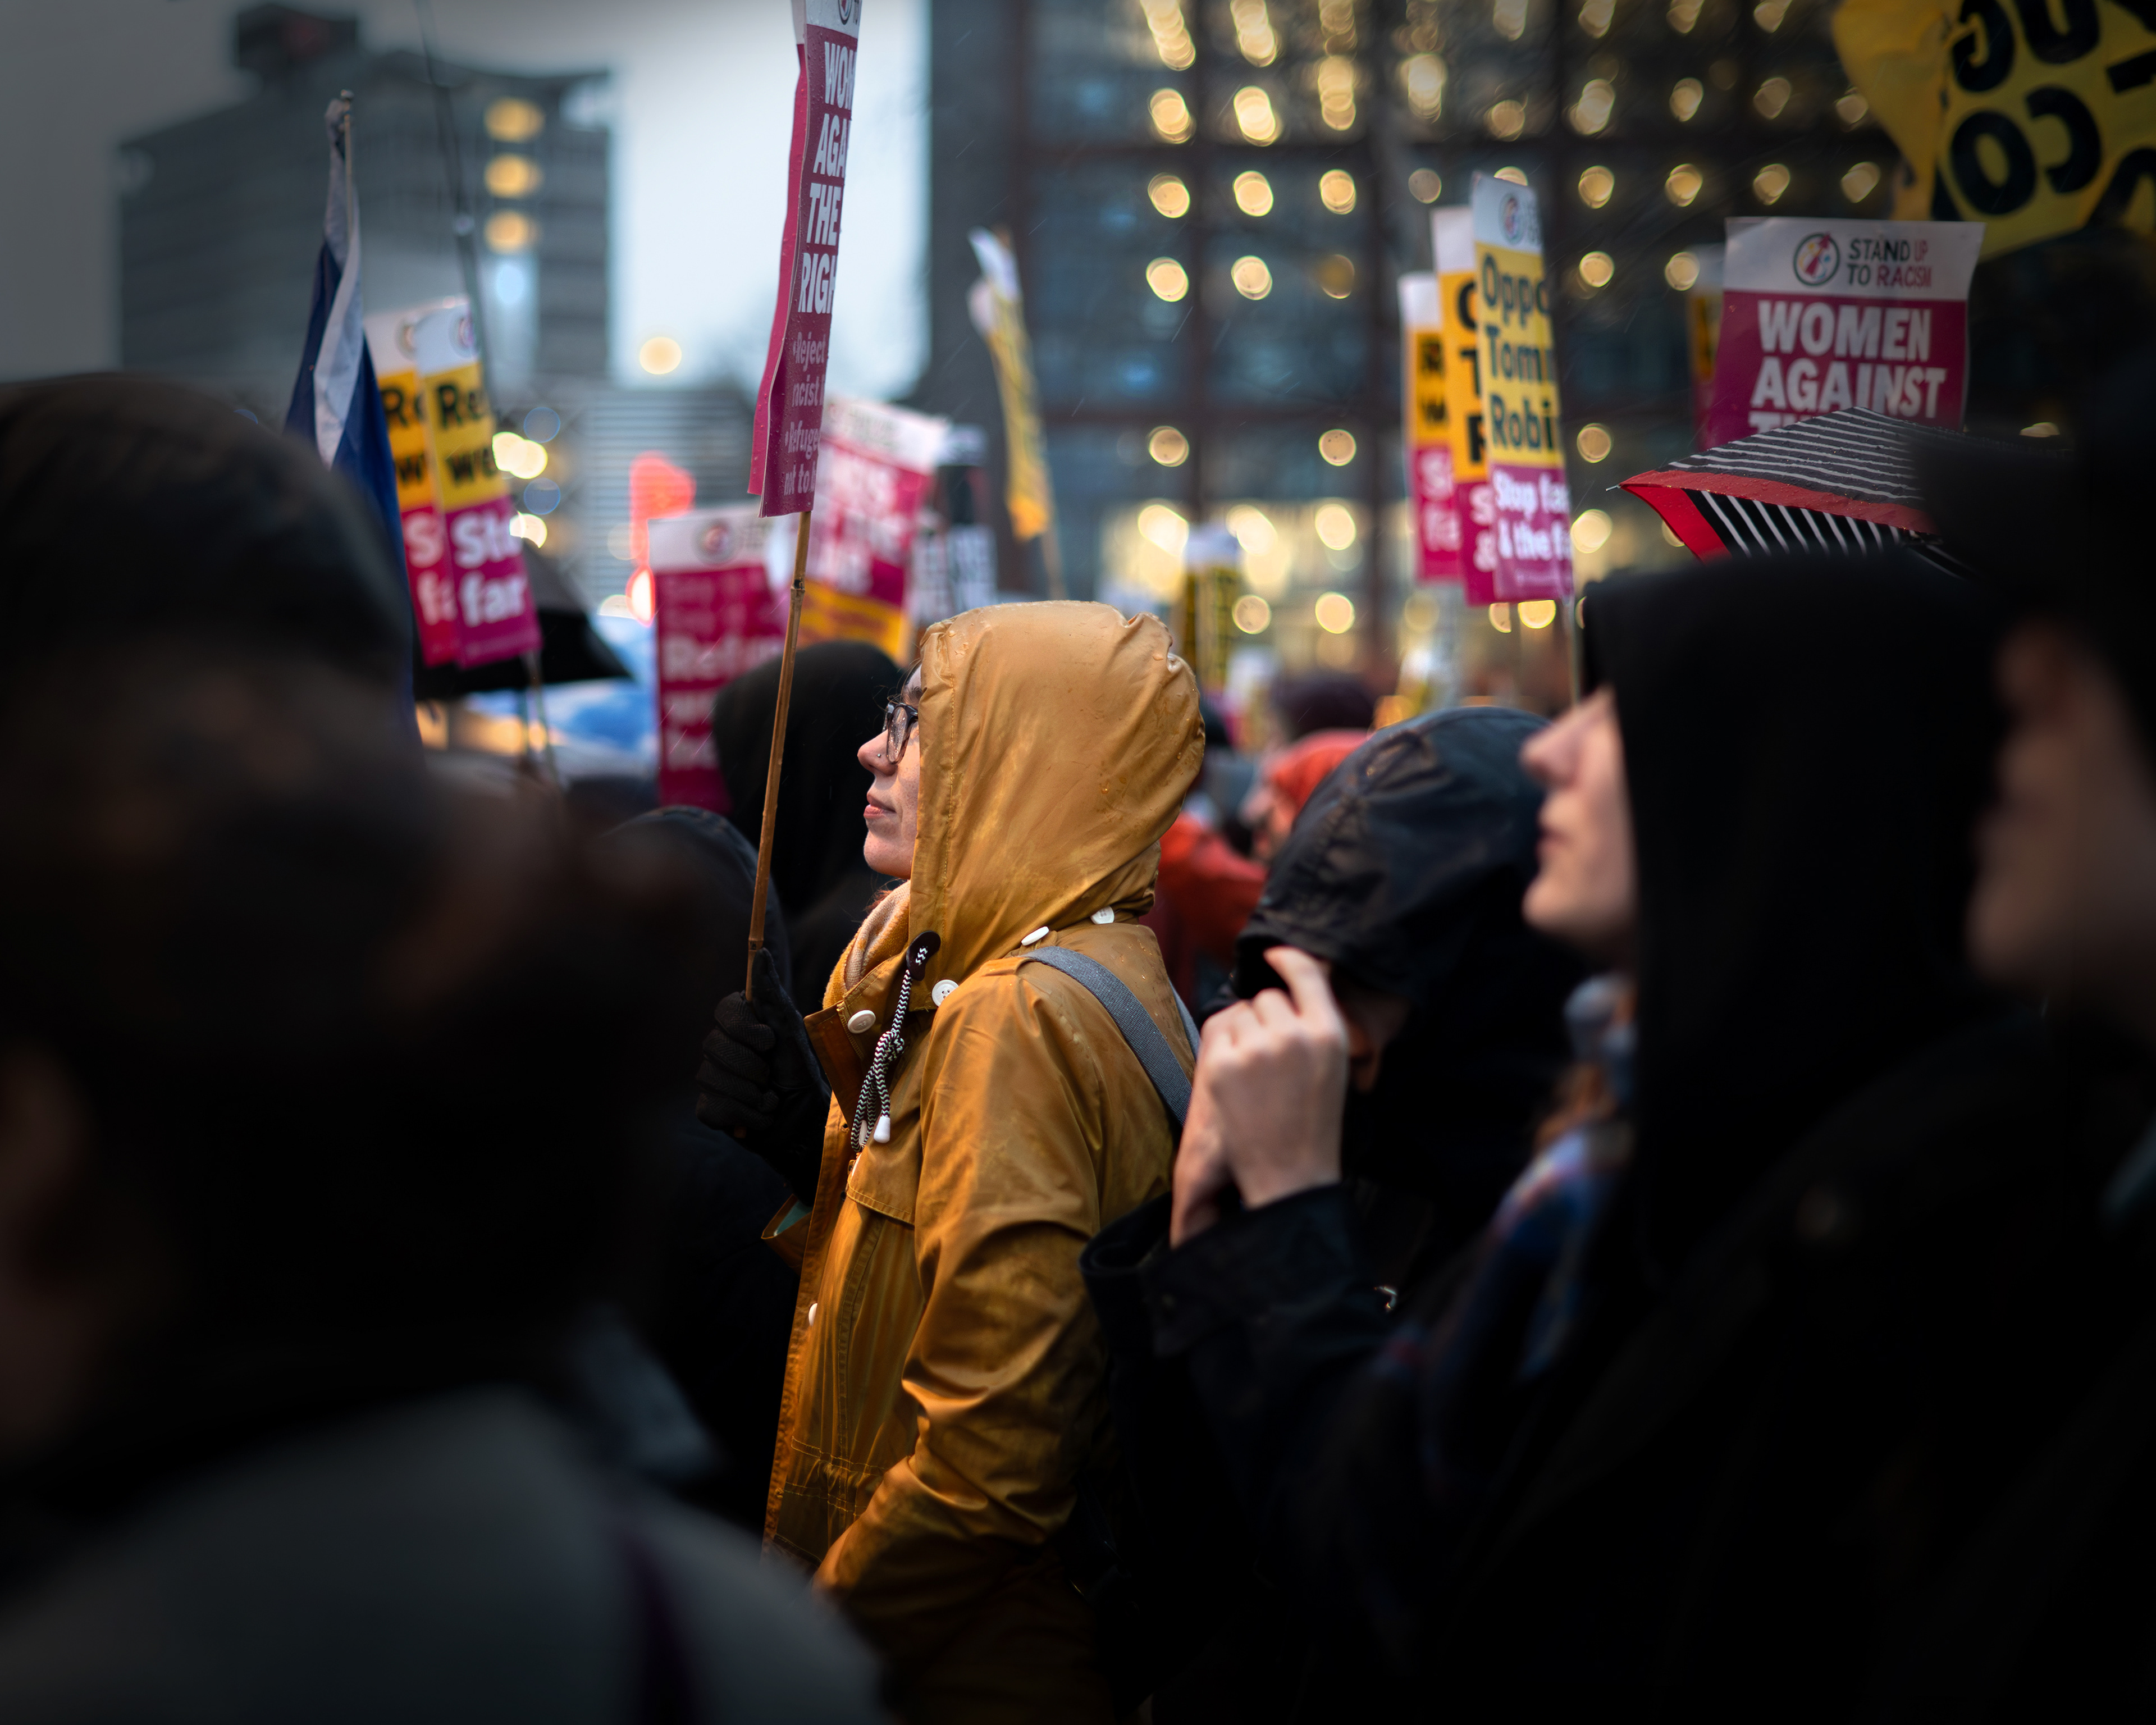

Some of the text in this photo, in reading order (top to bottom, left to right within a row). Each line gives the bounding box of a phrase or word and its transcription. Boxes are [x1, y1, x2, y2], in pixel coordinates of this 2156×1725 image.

[806, 182, 842, 246] THE
[1848, 238, 1929, 262] STAND UP
[1847, 263, 1871, 286] TO
[796, 330, 826, 372] Reject
[1758, 300, 1931, 363] WOMEN
[1750, 356, 1947, 419] AGAINST
[798, 463, 810, 494] to
